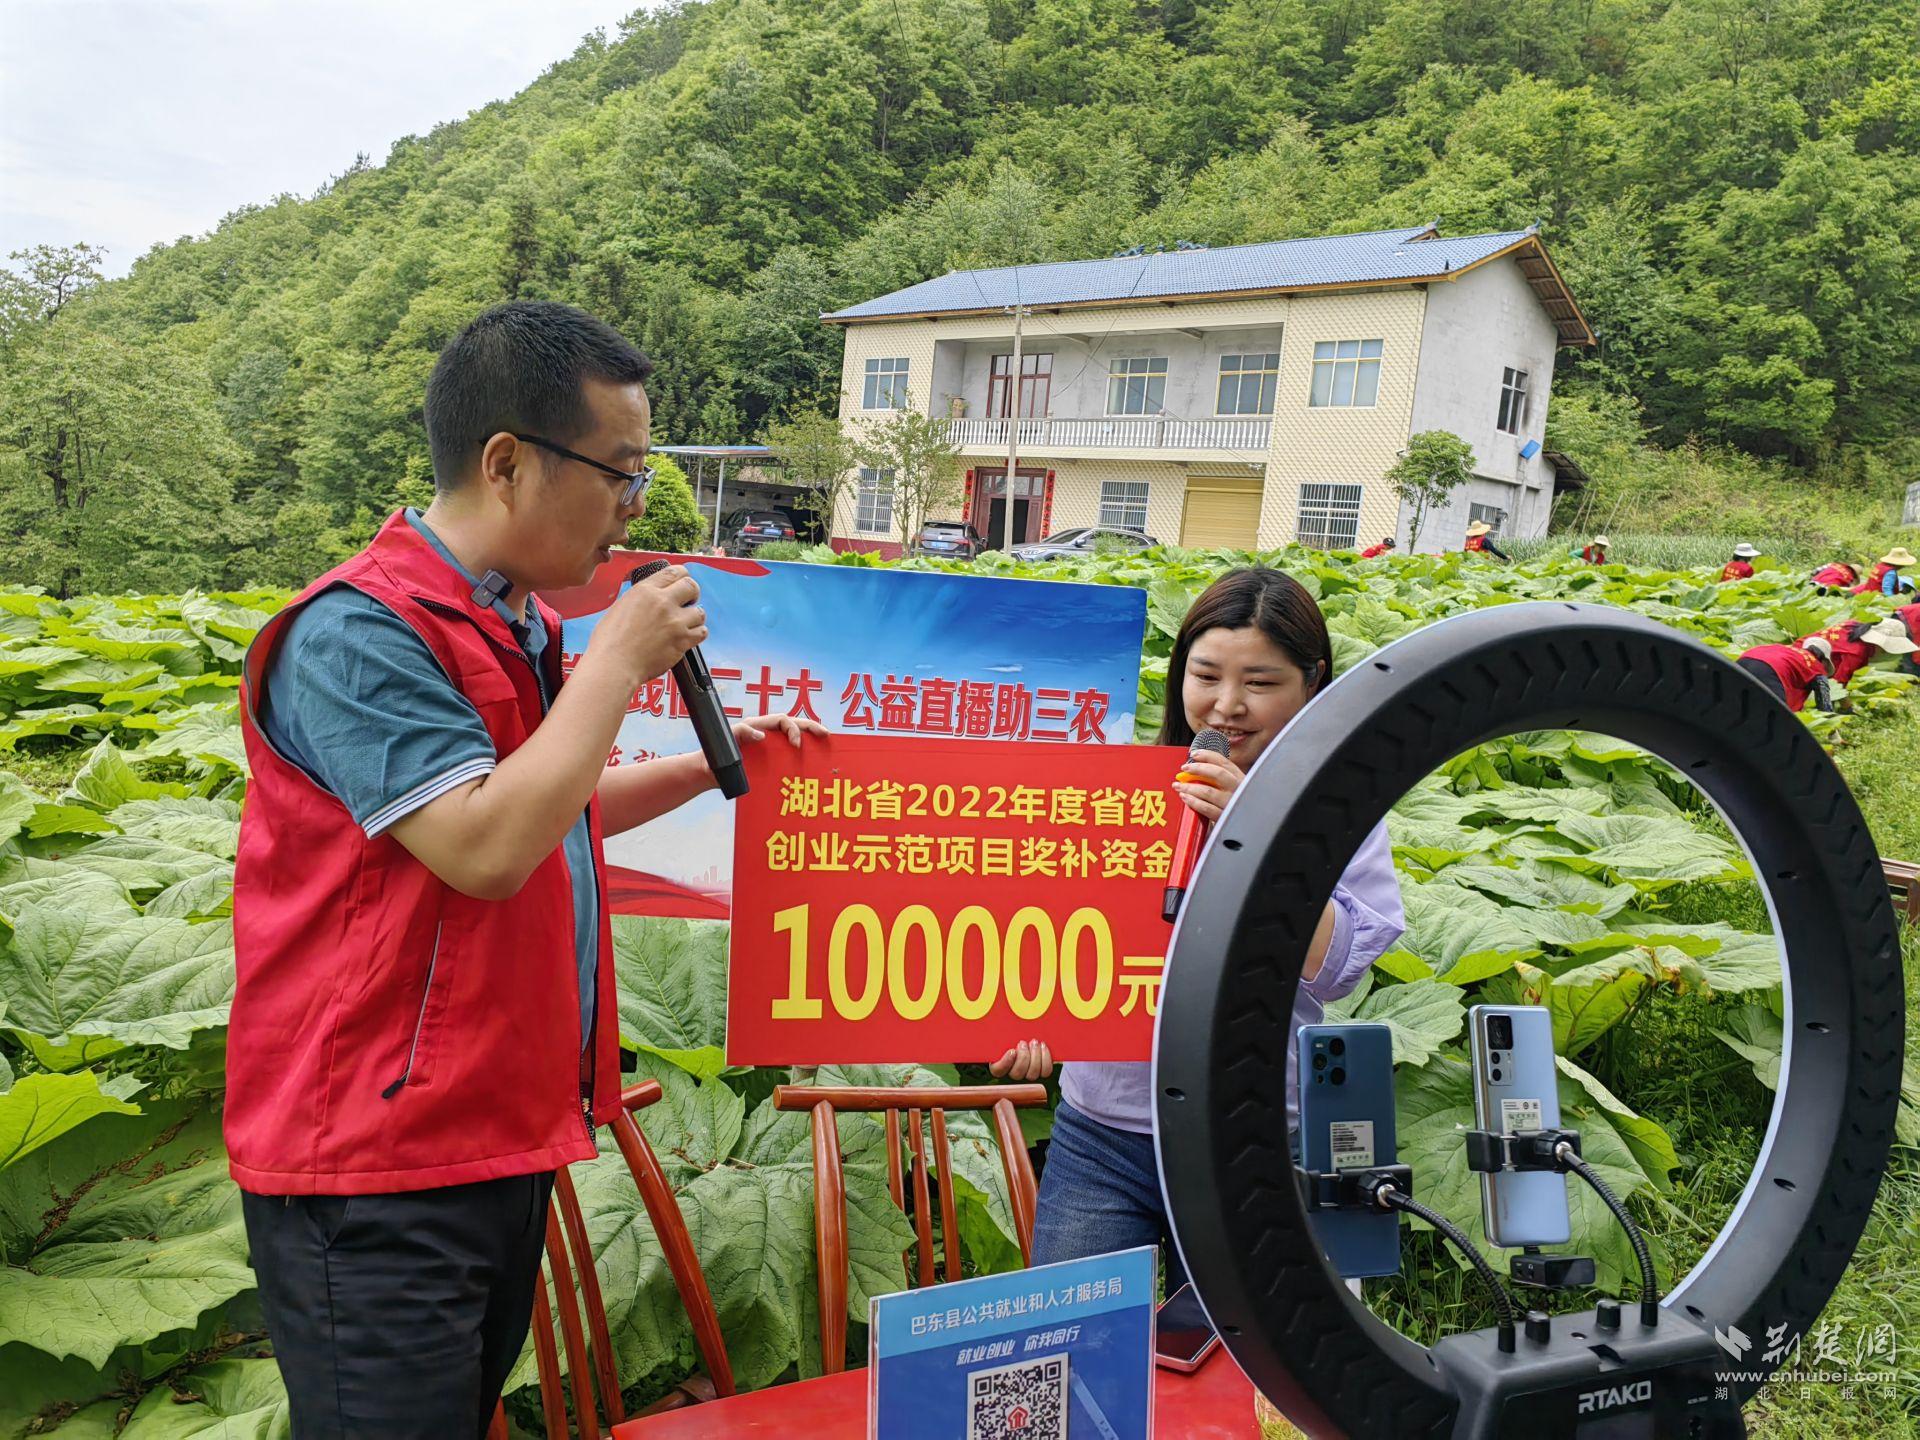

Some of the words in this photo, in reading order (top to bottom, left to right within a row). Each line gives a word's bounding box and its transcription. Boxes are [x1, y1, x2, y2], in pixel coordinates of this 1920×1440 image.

[840, 672, 1110, 743] 公益直播助三农
[779, 776, 1168, 828] 湖北省2022年度省级
[765, 830, 1173, 879] 创业示范项目奖补资金
[771, 903, 1165, 1021] 100000元
[911, 1276, 1123, 1336] 巴东县公共就业和人才服务局
[956, 1338, 1017, 1366] 就业创业
[1024, 1324, 1082, 1352] 你我同行
[1578, 1380, 1652, 1414] RTAKO
